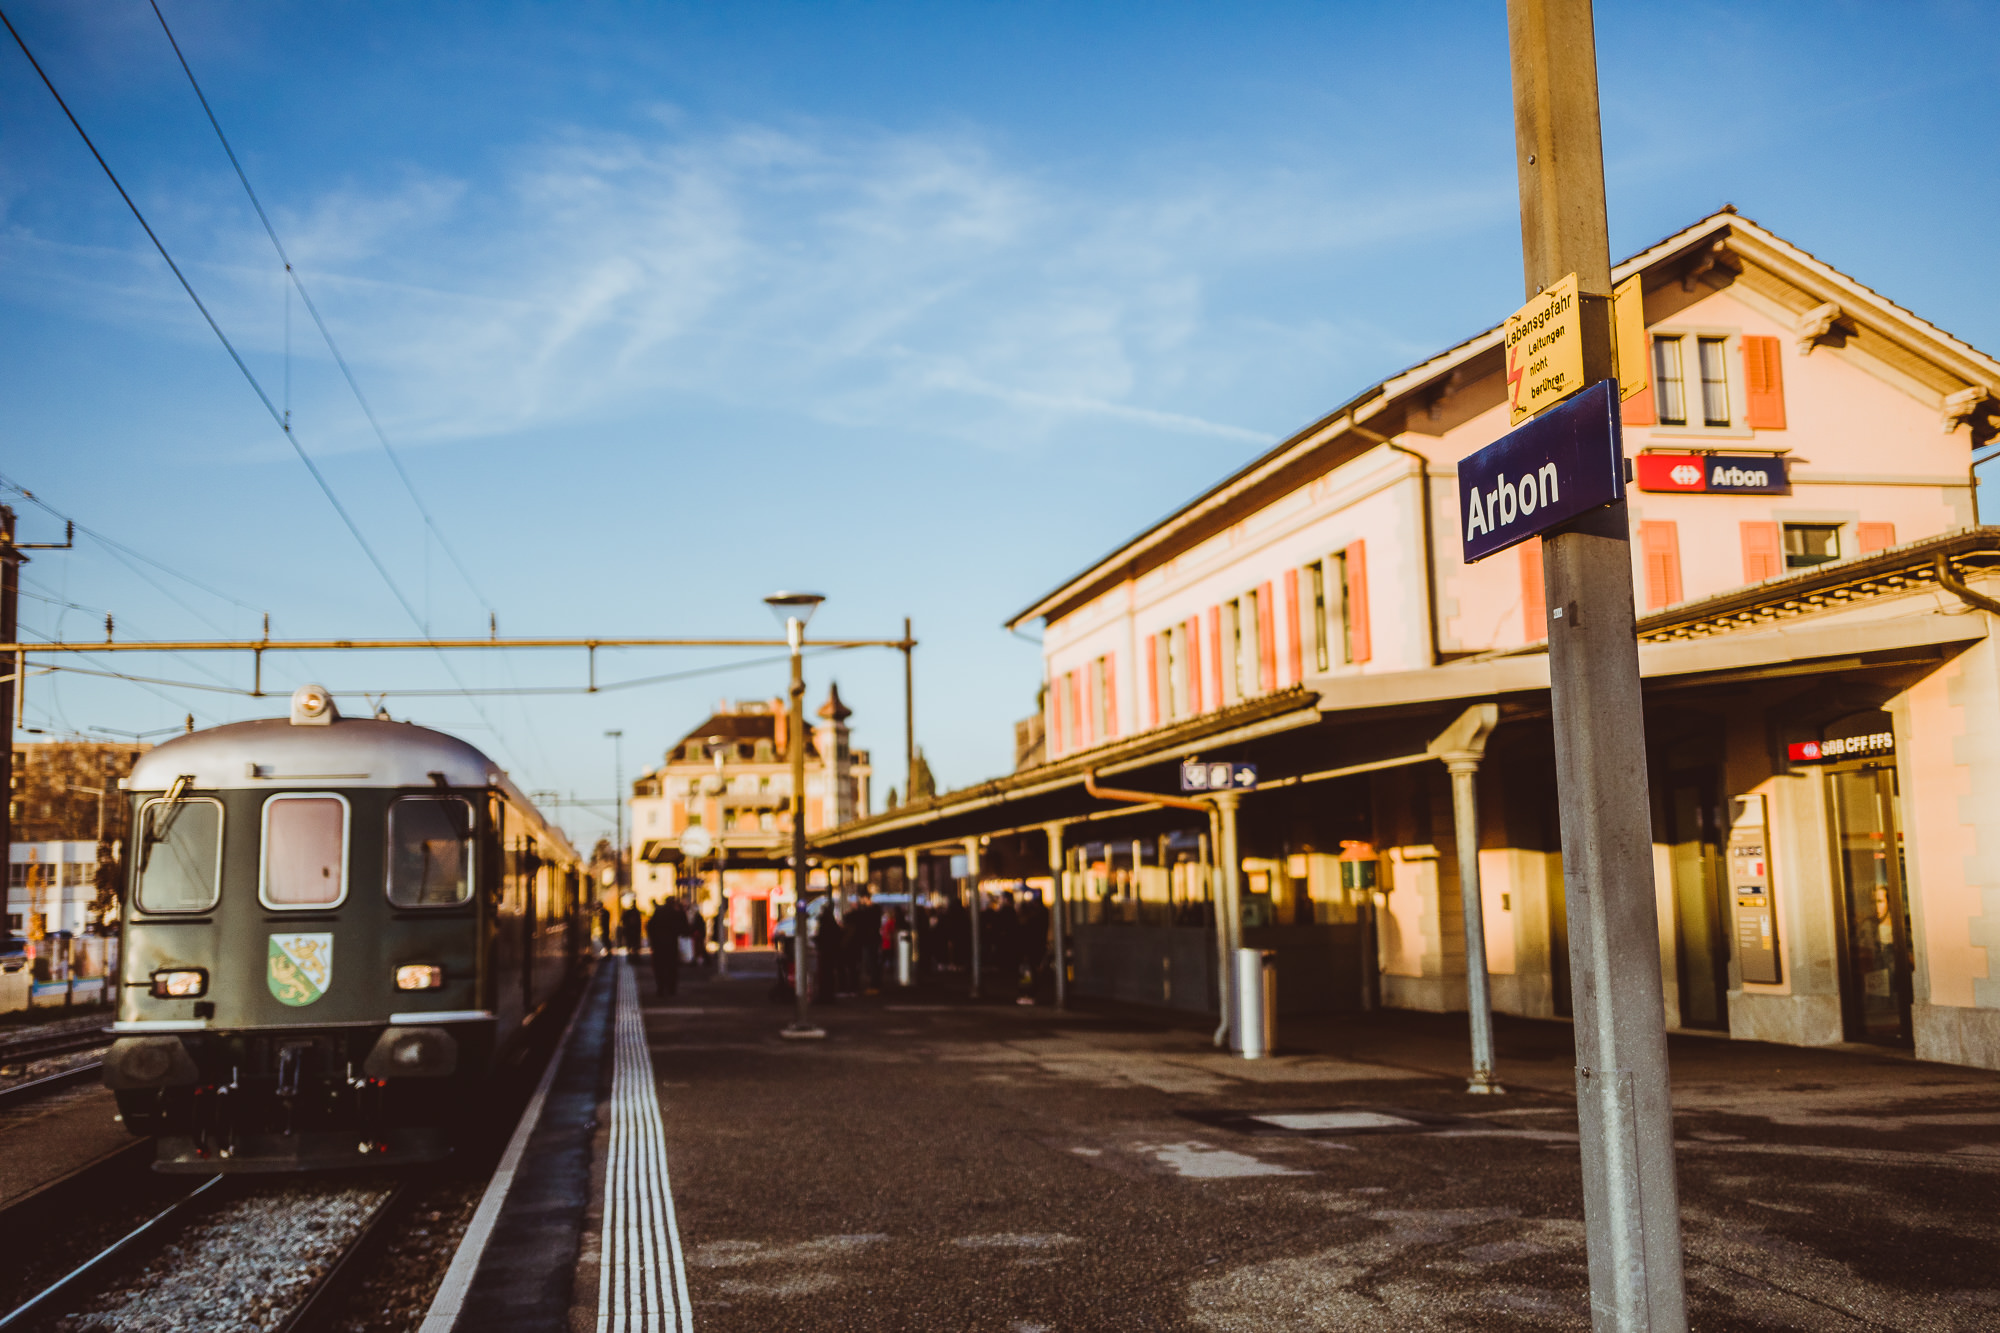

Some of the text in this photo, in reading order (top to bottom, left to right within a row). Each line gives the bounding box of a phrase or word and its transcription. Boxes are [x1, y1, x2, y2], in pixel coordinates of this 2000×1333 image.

[1506, 294, 1571, 349] Lebensgefahr
[1528, 325, 1565, 356] Leitungen
[1530, 356, 1548, 376] nicht
[1531, 372, 1565, 399] berühren
[1711, 465, 1768, 487] Arbon
[1467, 462, 1559, 542] Arbon
[1821, 732, 1893, 756] SBB CFF FFS
